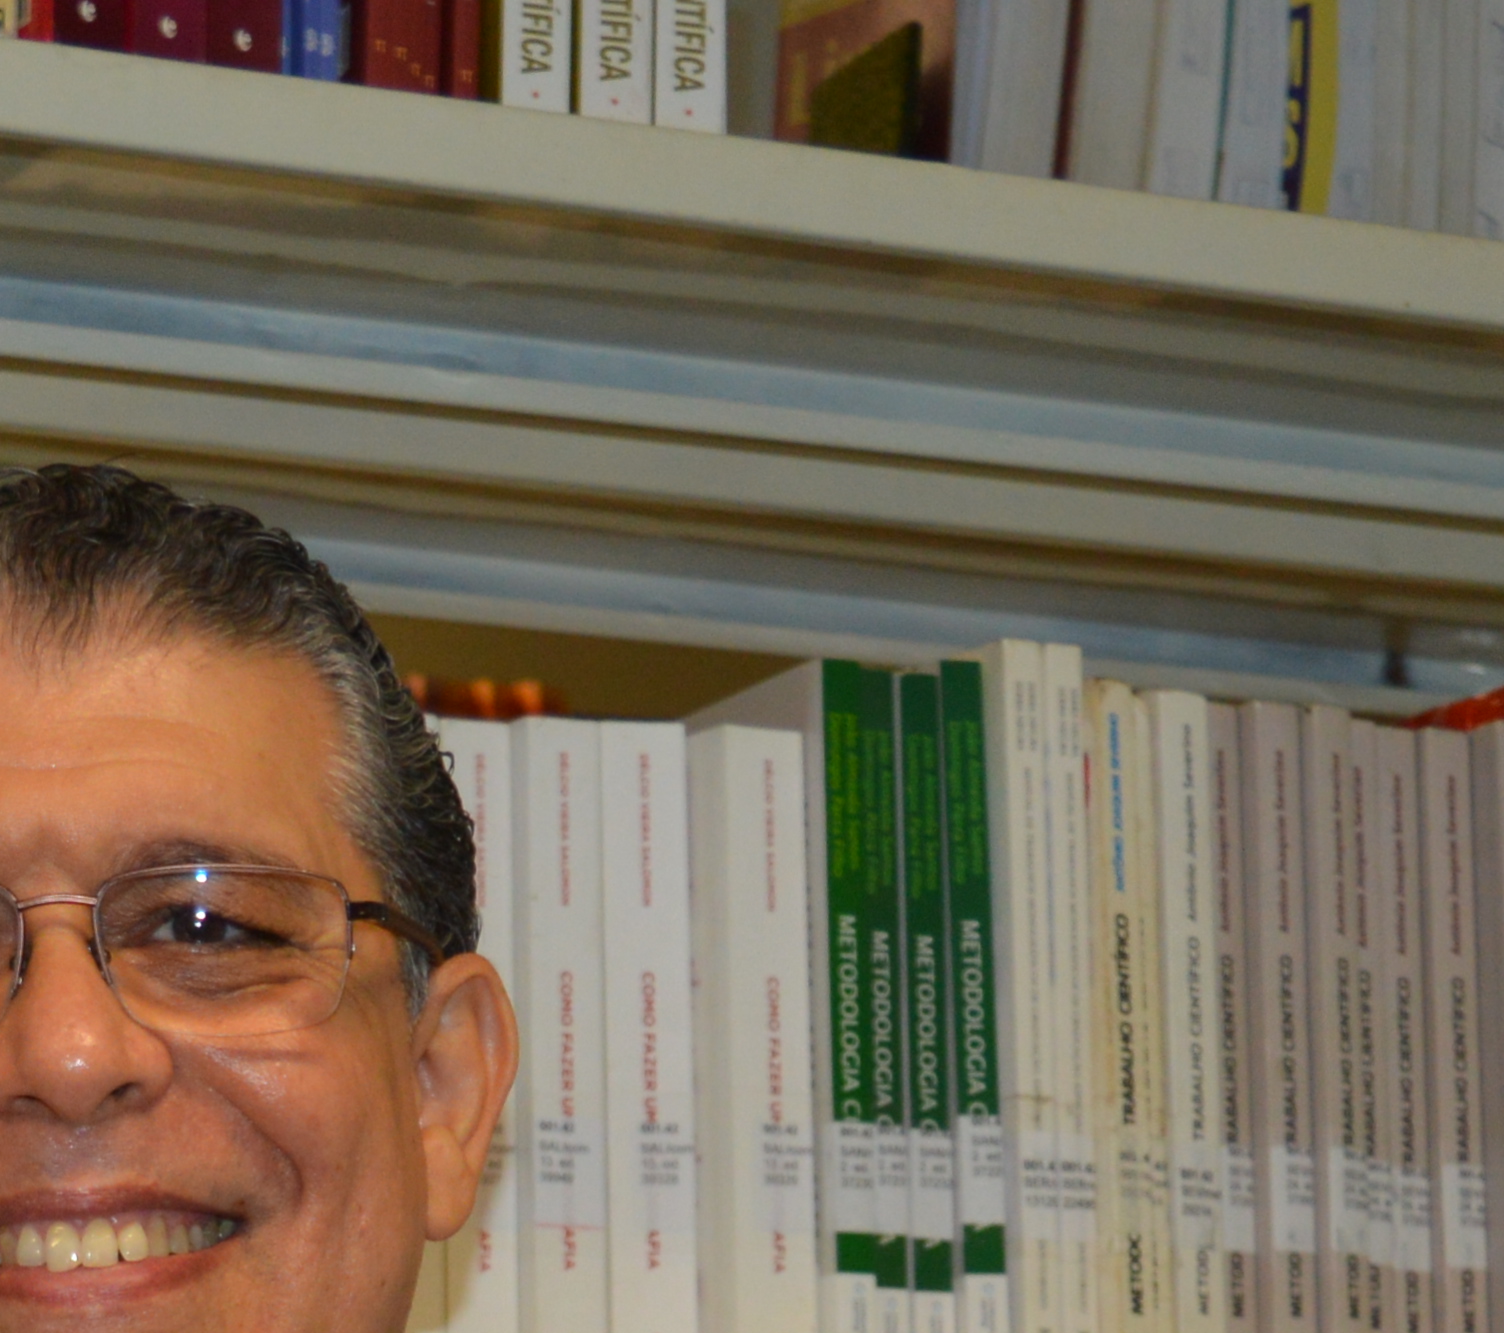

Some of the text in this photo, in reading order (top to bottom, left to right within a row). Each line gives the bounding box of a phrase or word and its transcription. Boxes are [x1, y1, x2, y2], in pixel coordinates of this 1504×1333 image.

[641, 971, 657, 1092] COMO FAZER
[766, 976, 783, 1097] COMO FAZER
[837, 914, 862, 1093] METODOLOGIA
[959, 919, 985, 1095] METODOLOGIA
